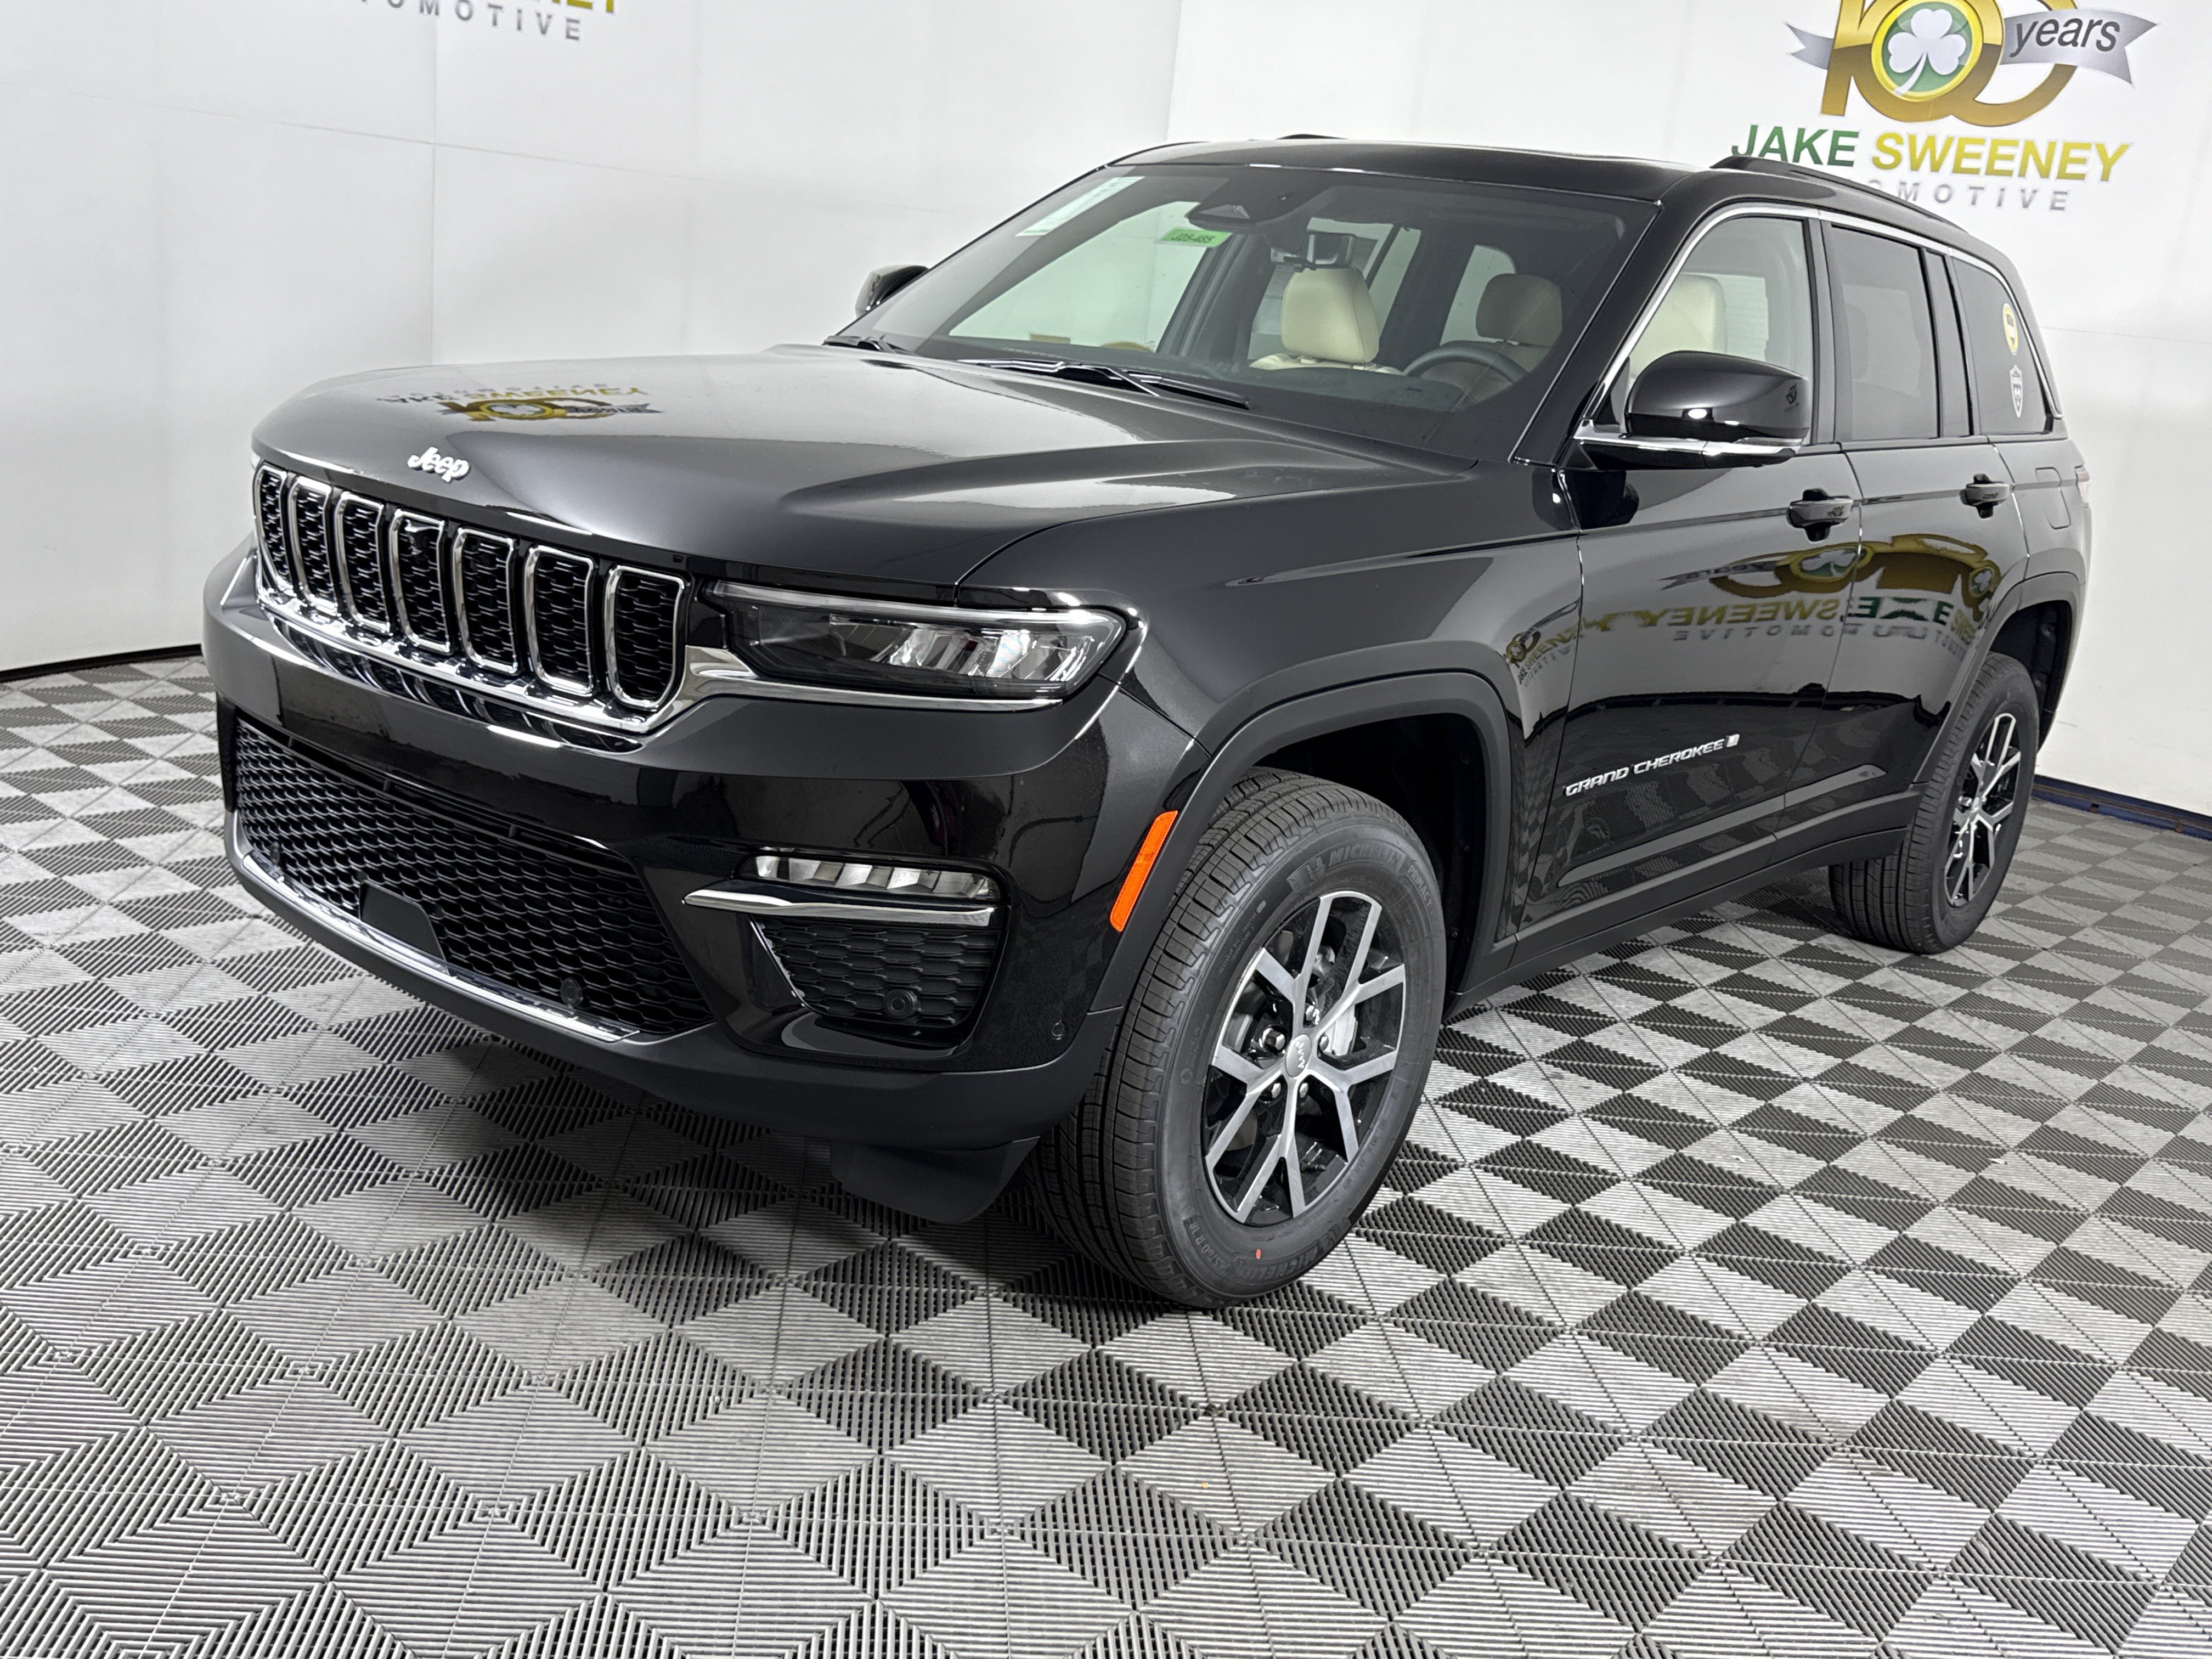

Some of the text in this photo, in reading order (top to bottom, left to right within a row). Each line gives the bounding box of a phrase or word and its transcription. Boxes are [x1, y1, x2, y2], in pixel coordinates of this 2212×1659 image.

[2010, 17, 2121, 57] years
[1731, 124, 2131, 183] JAKE SWEENEY
[1868, 179, 2070, 212] MOTIVE
[407, 447, 471, 483] Jeep
[1565, 738, 1725, 797] GRAND CHEROKEE
[1328, 843, 1432, 907] MICHELIN PRIMACY
